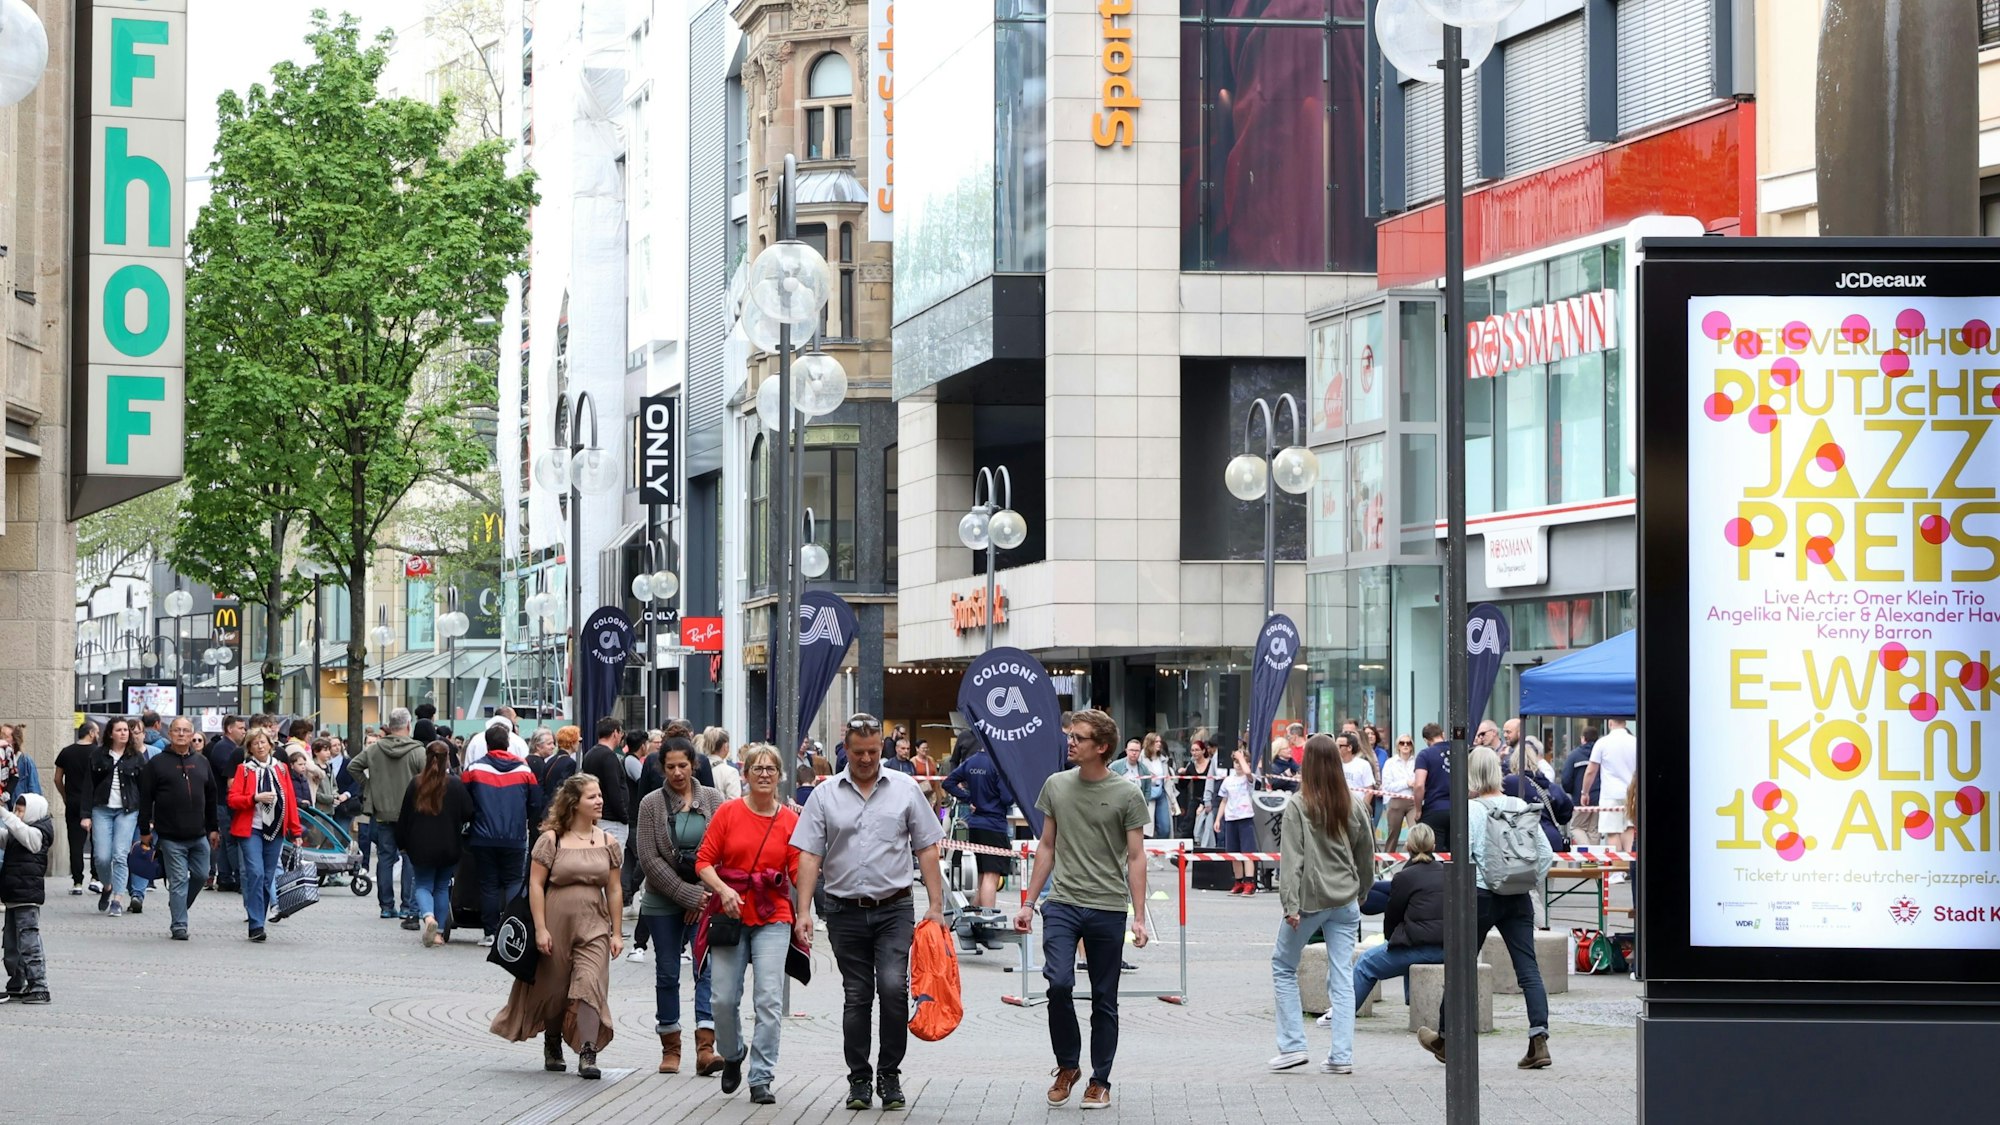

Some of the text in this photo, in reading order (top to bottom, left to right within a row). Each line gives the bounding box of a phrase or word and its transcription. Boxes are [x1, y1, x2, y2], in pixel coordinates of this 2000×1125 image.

[1835, 272, 1926, 288] JCDecaux
[1467, 290, 1613, 379] ROSSMANN
[646, 404, 669, 497] ONLY
[1743, 418, 1996, 499] JAZZ
[1489, 536, 1532, 559] ROSSMANN
[1737, 501, 2000, 582] PREIS
[1764, 589, 1985, 605] Live Acts: Omer Klein Trio
[593, 616, 628, 632] COLOGNE
[644, 611, 675, 621] ONLY
[1707, 606, 1781, 626] Angelika
[1787, 606, 1856, 622] Niescier
[1860, 607, 1871, 622] &
[1875, 607, 1964, 622] Alexander
[599, 630, 621, 649] CA
[687, 623, 721, 643] Ray-Ban
[1266, 623, 1294, 638] COLOGNE
[1466, 617, 1500, 655] CA
[1817, 624, 1932, 644] Kenny Barron
[1270, 637, 1288, 655] CA
[592, 649, 626, 664] ATHLETICS
[1264, 654, 1292, 670] ATHLETICS
[973, 662, 1038, 686] COLOGNE
[986, 686, 1029, 717] CA
[974, 716, 1043, 741] ATHLETICS
[1769, 712, 1981, 781] KÖLN
[1716, 788, 2000, 852] 18. APRI
[1734, 867, 1789, 882] Tickets
[1792, 869, 1839, 883] unter:
[1934, 905, 1985, 922] Stadt
